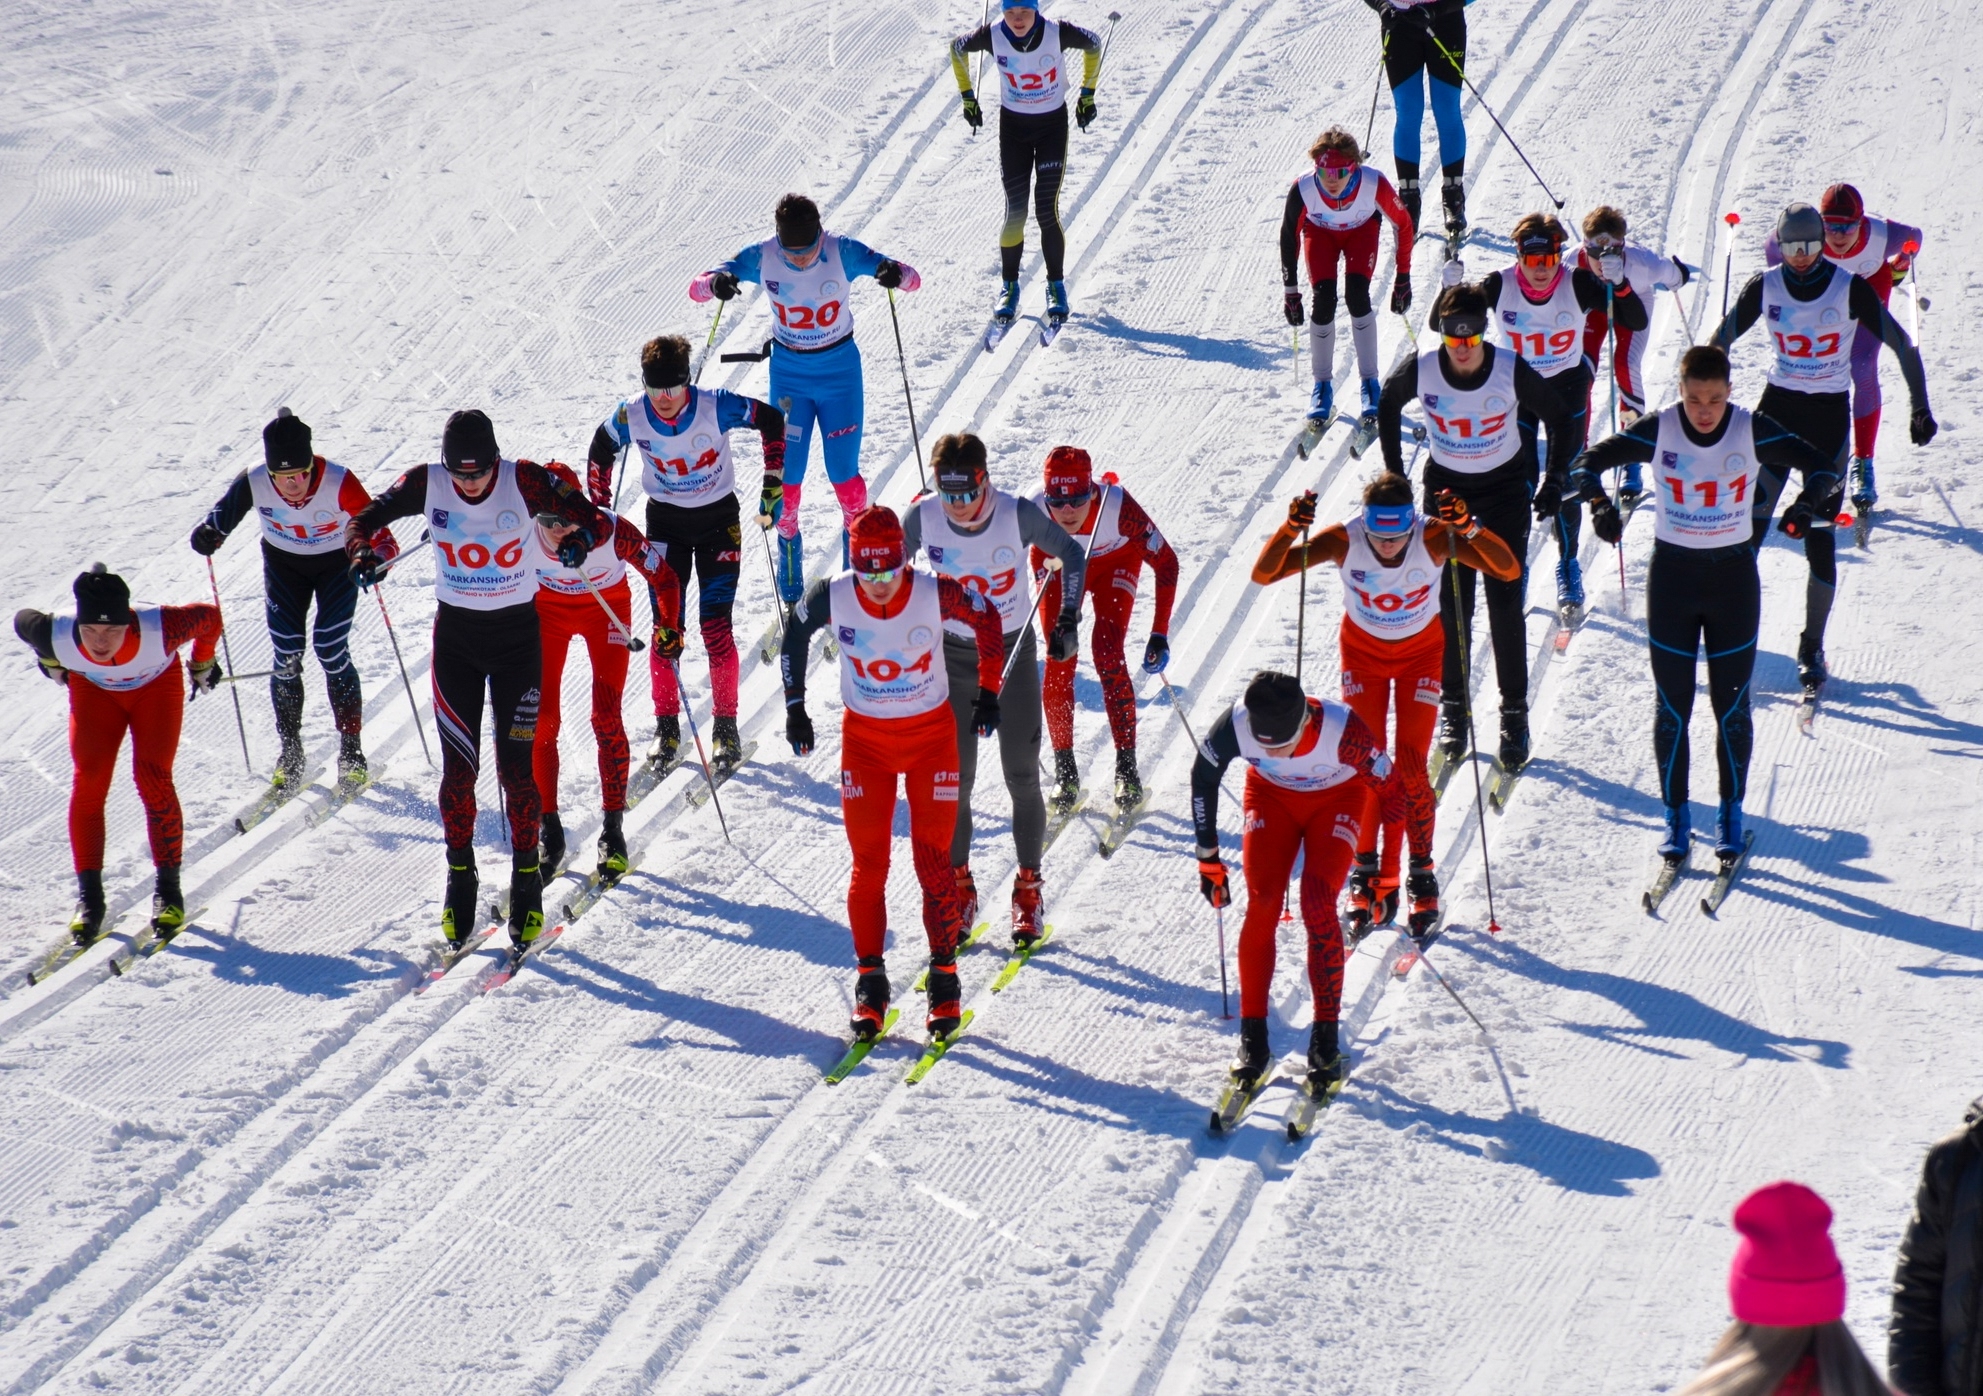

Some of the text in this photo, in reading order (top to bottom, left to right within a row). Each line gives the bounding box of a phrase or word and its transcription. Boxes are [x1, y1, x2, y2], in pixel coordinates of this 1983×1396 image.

[1004, 67, 1057, 90] 121
[773, 300, 840, 329] 120
[1506, 329, 1576, 356] 119
[1774, 331, 1840, 358] 122
[1428, 413, 1507, 438] 112
[647, 448, 720, 476] 114
[1060, 476, 1078, 484] ПСБ
[1664, 473, 1748, 508] 111
[1665, 507, 1745, 523] SHARKANSHOP.RU
[437, 538, 522, 569] 106
[716, 551, 742, 562] KV
[871, 547, 890, 556] ПСБ
[442, 570, 525, 584] SHARKANSHOP.RU
[958, 568, 1016, 597] 03
[1068, 572, 1080, 600] VMAX
[1353, 585, 1430, 612] 102
[847, 649, 932, 682] 104
[1194, 797, 1206, 824] VMAX
